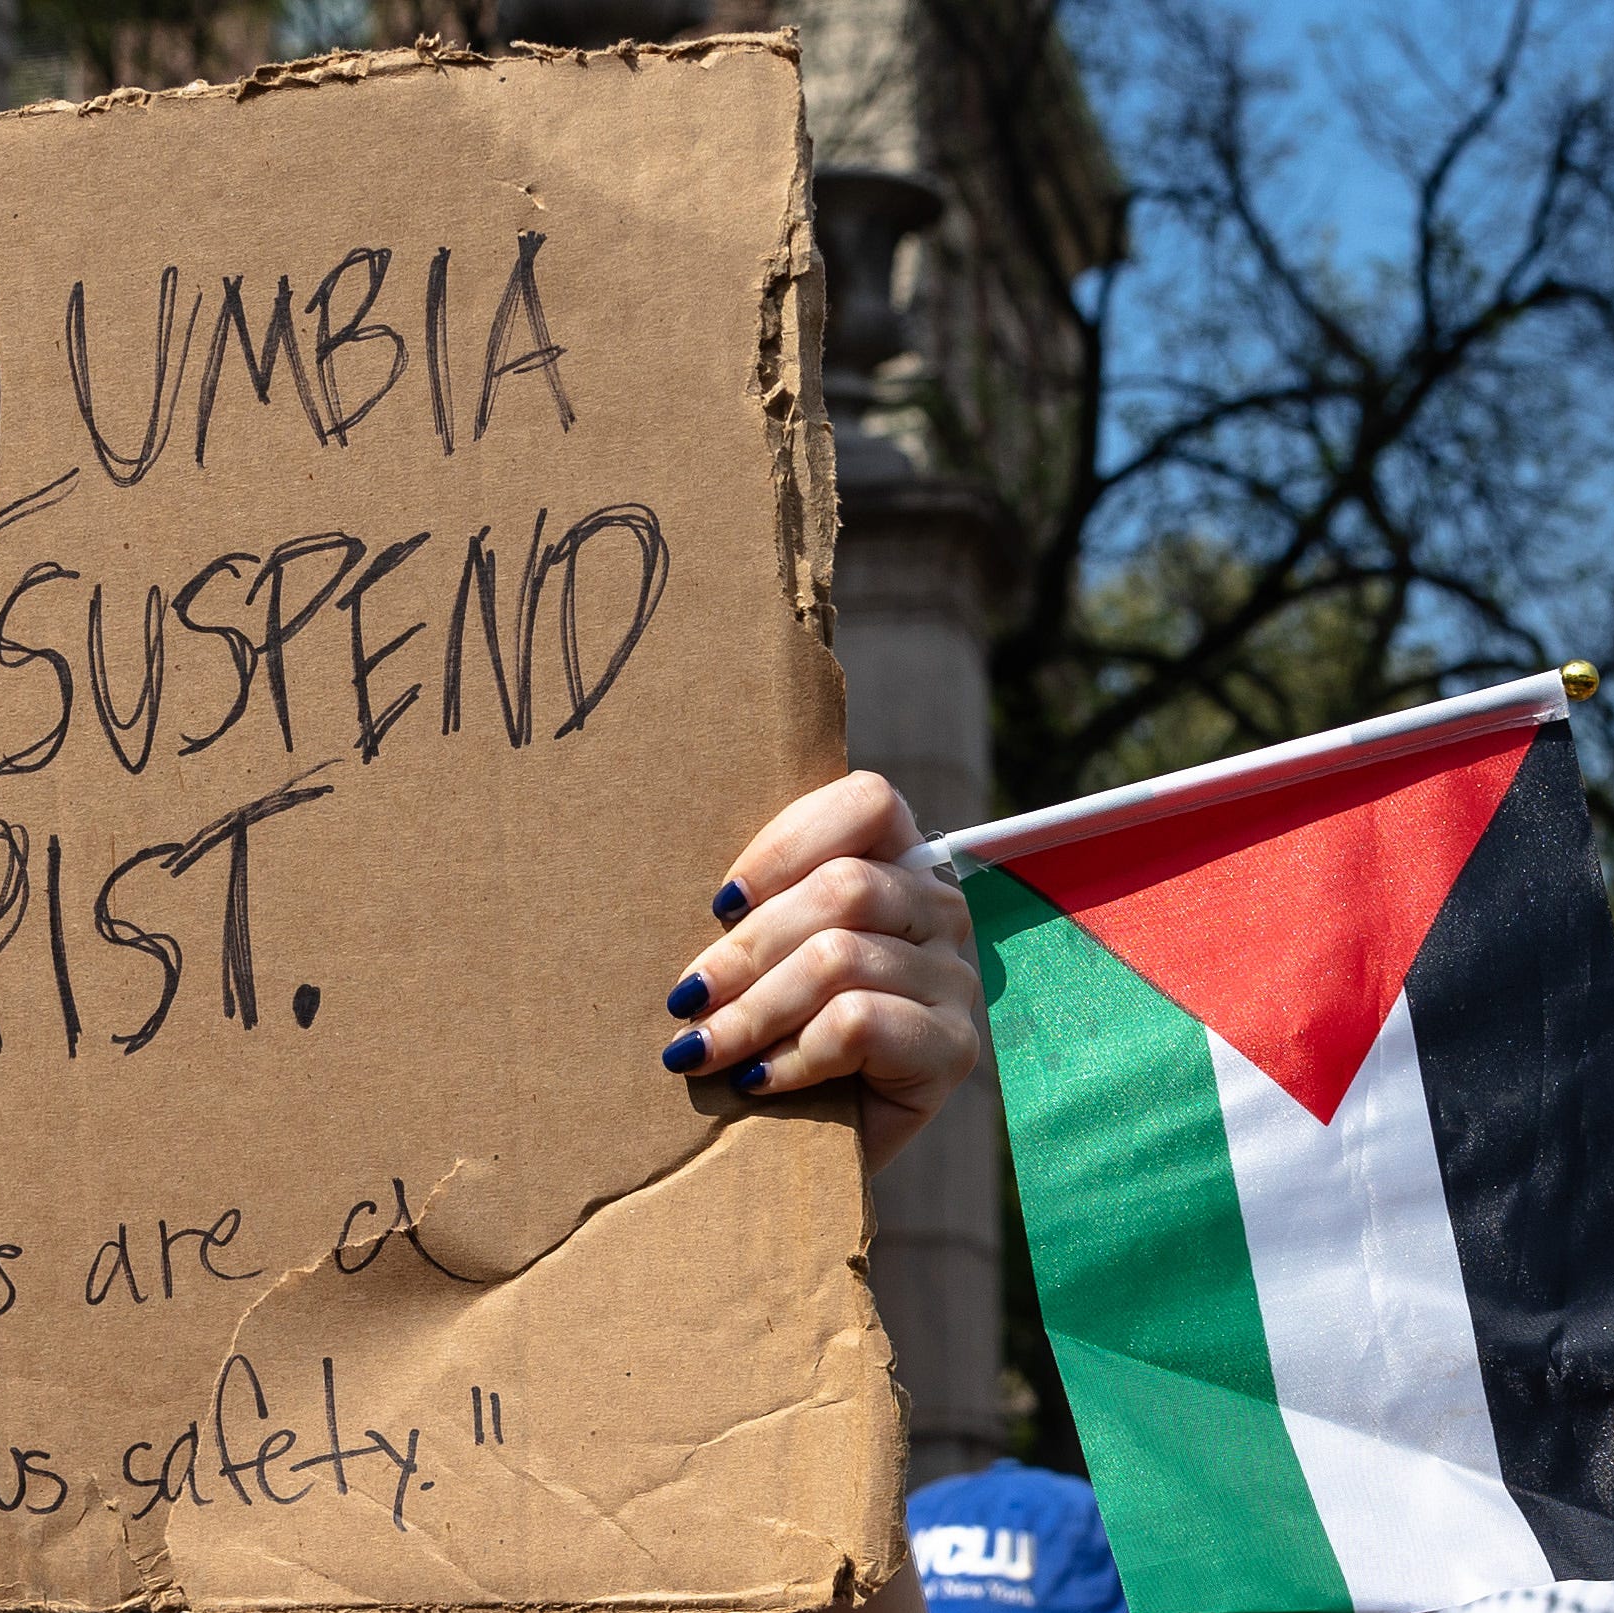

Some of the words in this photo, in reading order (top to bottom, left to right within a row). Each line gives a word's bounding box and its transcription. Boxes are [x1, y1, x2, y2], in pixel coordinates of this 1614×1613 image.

[85, 1207, 263, 1306] are
[334, 1177, 489, 1285] a
[122, 1352, 506, 1533] safety."
[911, 1525, 1036, 1581] YCLU
